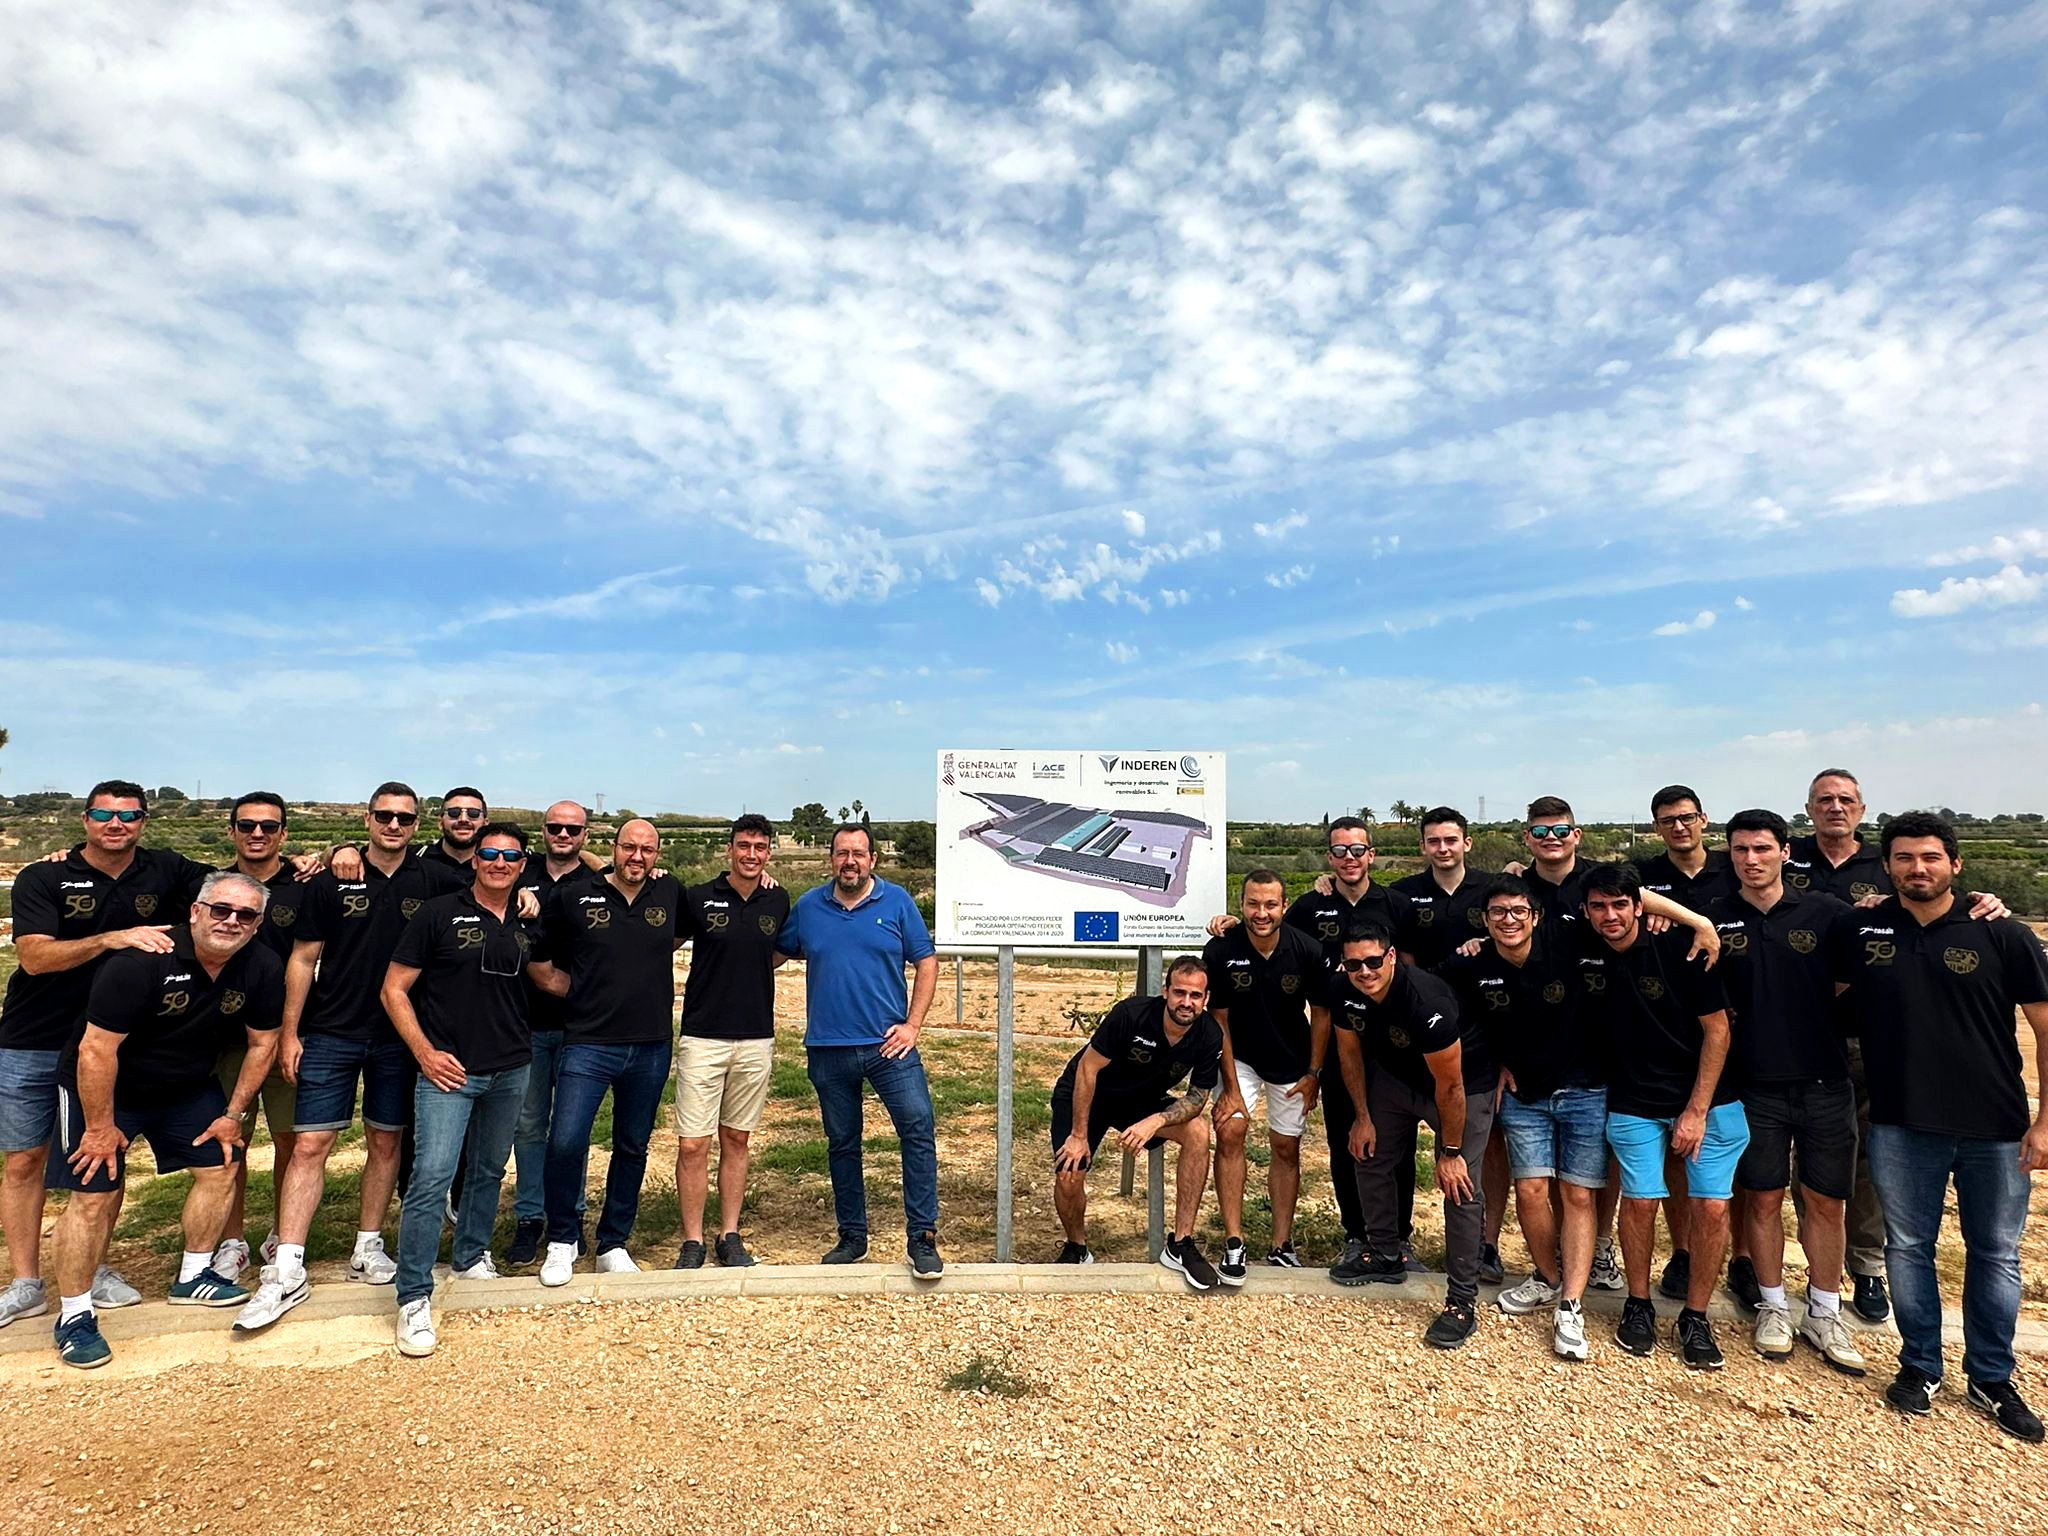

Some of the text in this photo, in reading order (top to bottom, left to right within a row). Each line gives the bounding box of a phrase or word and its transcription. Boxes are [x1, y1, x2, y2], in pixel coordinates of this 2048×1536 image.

[958, 761, 1018, 769] GENERALITAT
[959, 770, 1016, 779] VALENCIANA
[1121, 760, 1177, 771] INDEREN
[64, 894, 97, 919] 50
[342, 894, 370, 918] 50
[586, 907, 611, 929] 50
[706, 912, 730, 933] 50
[1123, 913, 1185, 922] UNIÓN EUROPEA
[457, 927, 484, 949] 50
[1722, 932, 1749, 957] 50
[1865, 940, 1897, 966] 50
[157, 990, 191, 1016] 50
